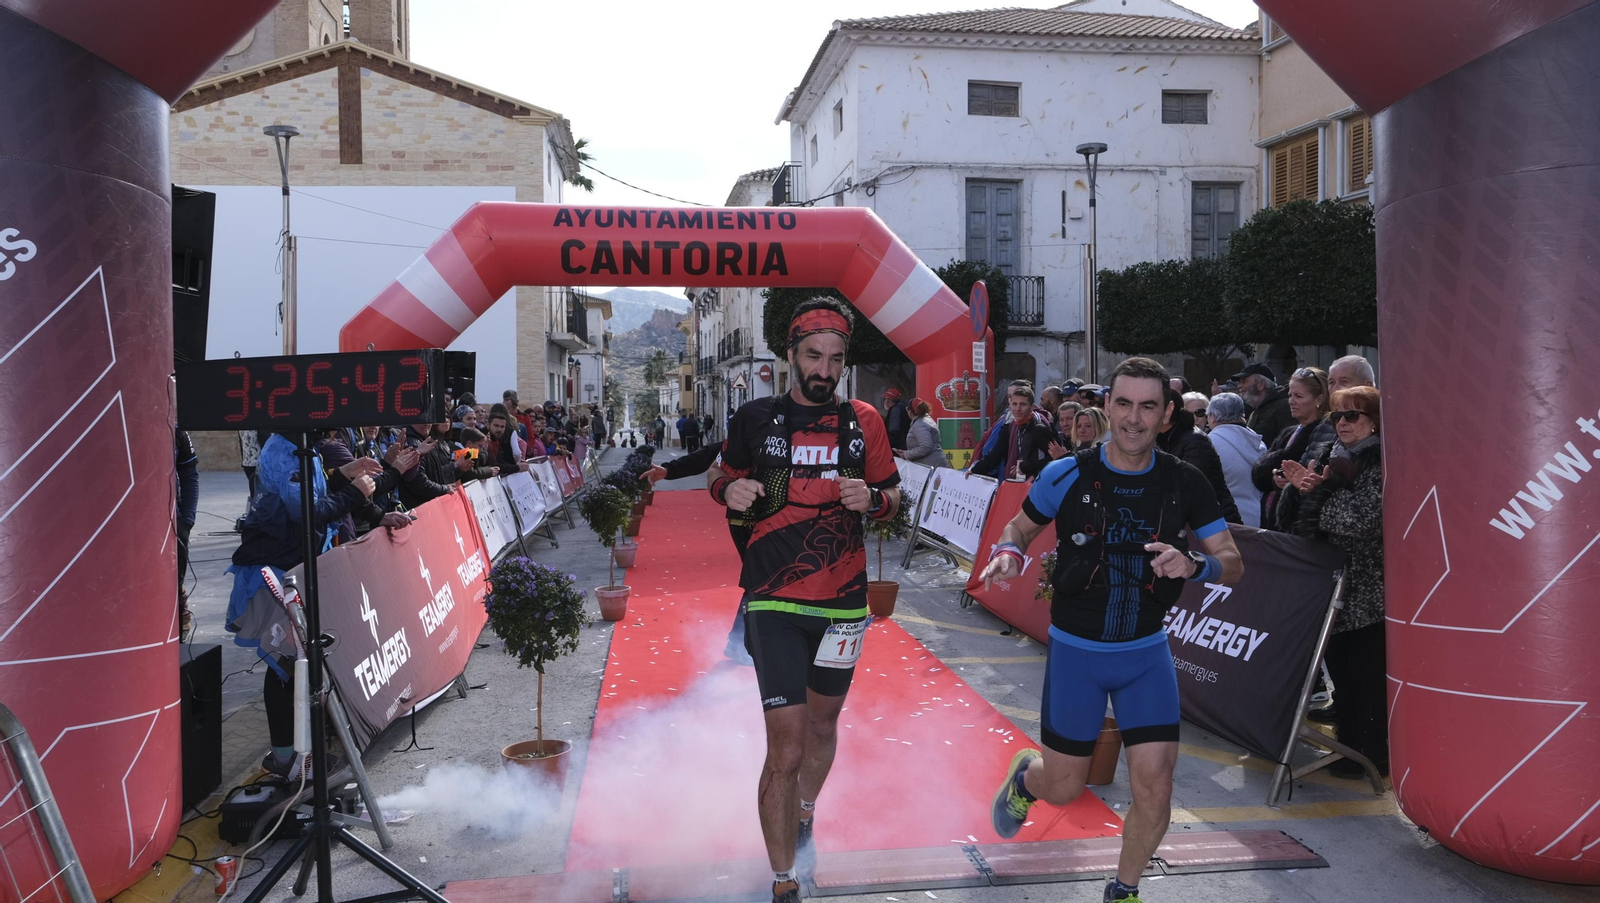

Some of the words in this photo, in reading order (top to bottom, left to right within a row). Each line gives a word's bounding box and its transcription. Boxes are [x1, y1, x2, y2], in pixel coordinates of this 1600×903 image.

[553, 208, 797, 230] AYUNTAMIENTO
[560, 239, 789, 276] CANTORIA
[224, 357, 427, 422] 3:25:42
[766, 446, 788, 458] MAX
[1113, 486, 1145, 495] land
[1489, 408, 1600, 540] www.t
[933, 496, 982, 534] CANTORIA
[418, 581, 455, 638] TEAMERGY
[1162, 605, 1269, 662] EAMERGY
[353, 627, 412, 702] TEAMERGY
[1172, 654, 1219, 683] teamergy.es
